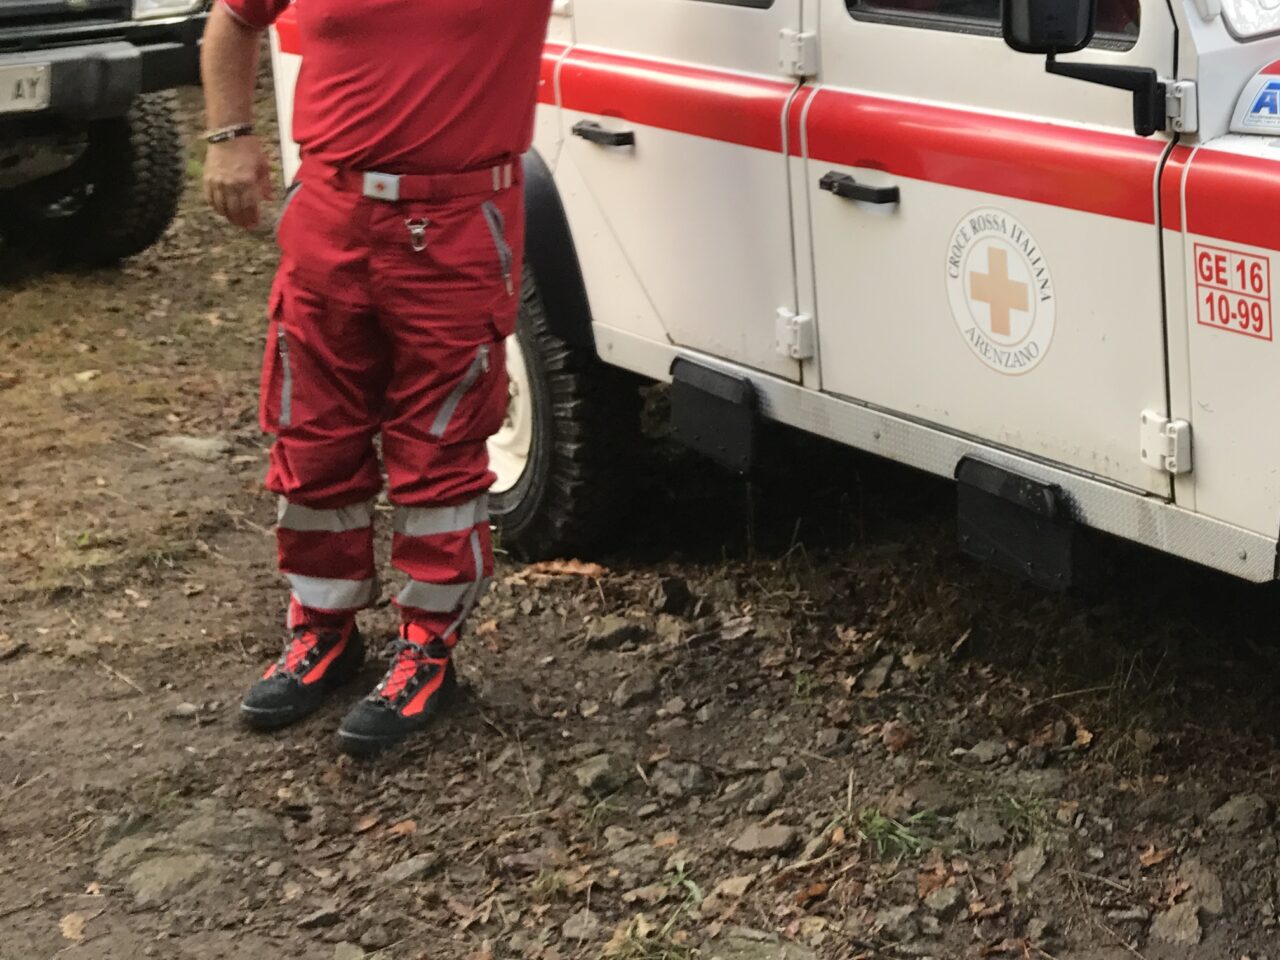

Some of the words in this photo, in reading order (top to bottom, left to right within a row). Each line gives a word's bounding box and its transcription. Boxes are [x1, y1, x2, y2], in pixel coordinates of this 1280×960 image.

[948, 226, 971, 279] CROCE
[969, 213, 1007, 236] ROSSA
[1198, 251, 1228, 286] GE
[1236, 259, 1263, 293] 16
[1205, 291, 1264, 333] 10-99
[965, 327, 1040, 368] ARENZANO
